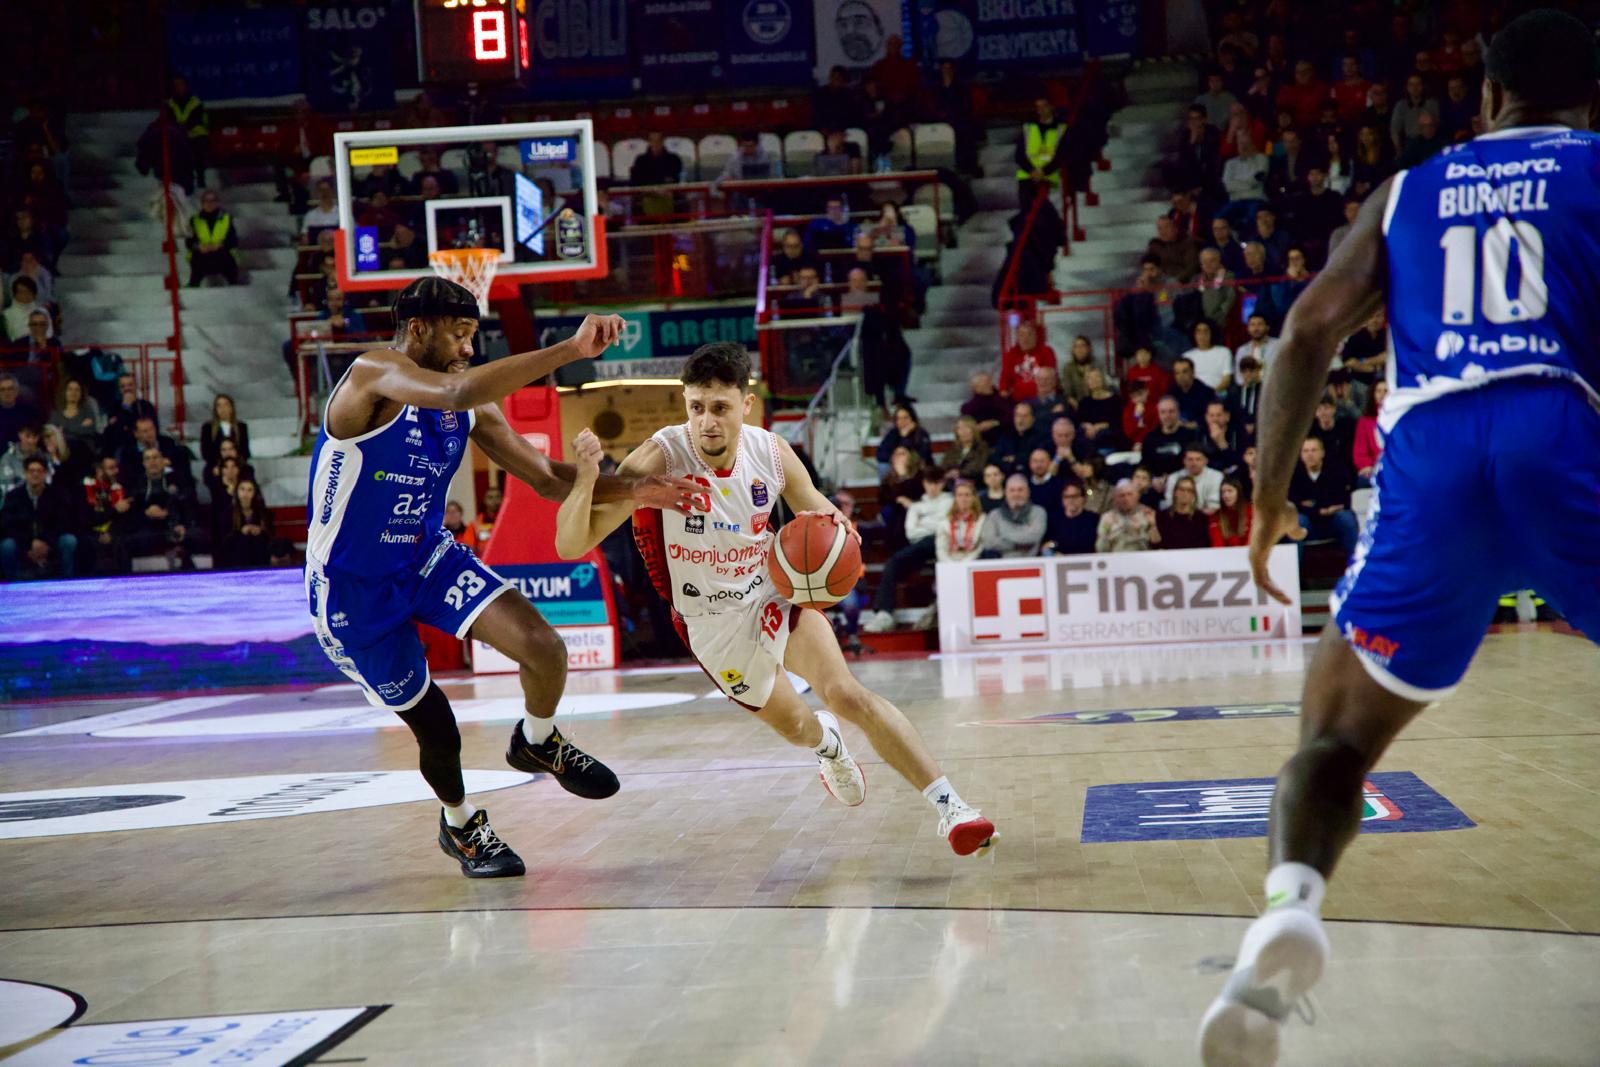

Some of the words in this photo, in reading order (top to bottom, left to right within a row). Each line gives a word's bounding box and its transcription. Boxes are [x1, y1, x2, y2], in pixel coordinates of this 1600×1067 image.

[473, 10, 507, 60] 8
[1440, 219, 1549, 325] 10
[1469, 333, 1561, 356] inblu
[444, 569, 487, 611] 23
[1058, 622, 1176, 642] SERRAMENTI
[1181, 619, 1199, 637] IN
[1205, 616, 1243, 635] PVC
